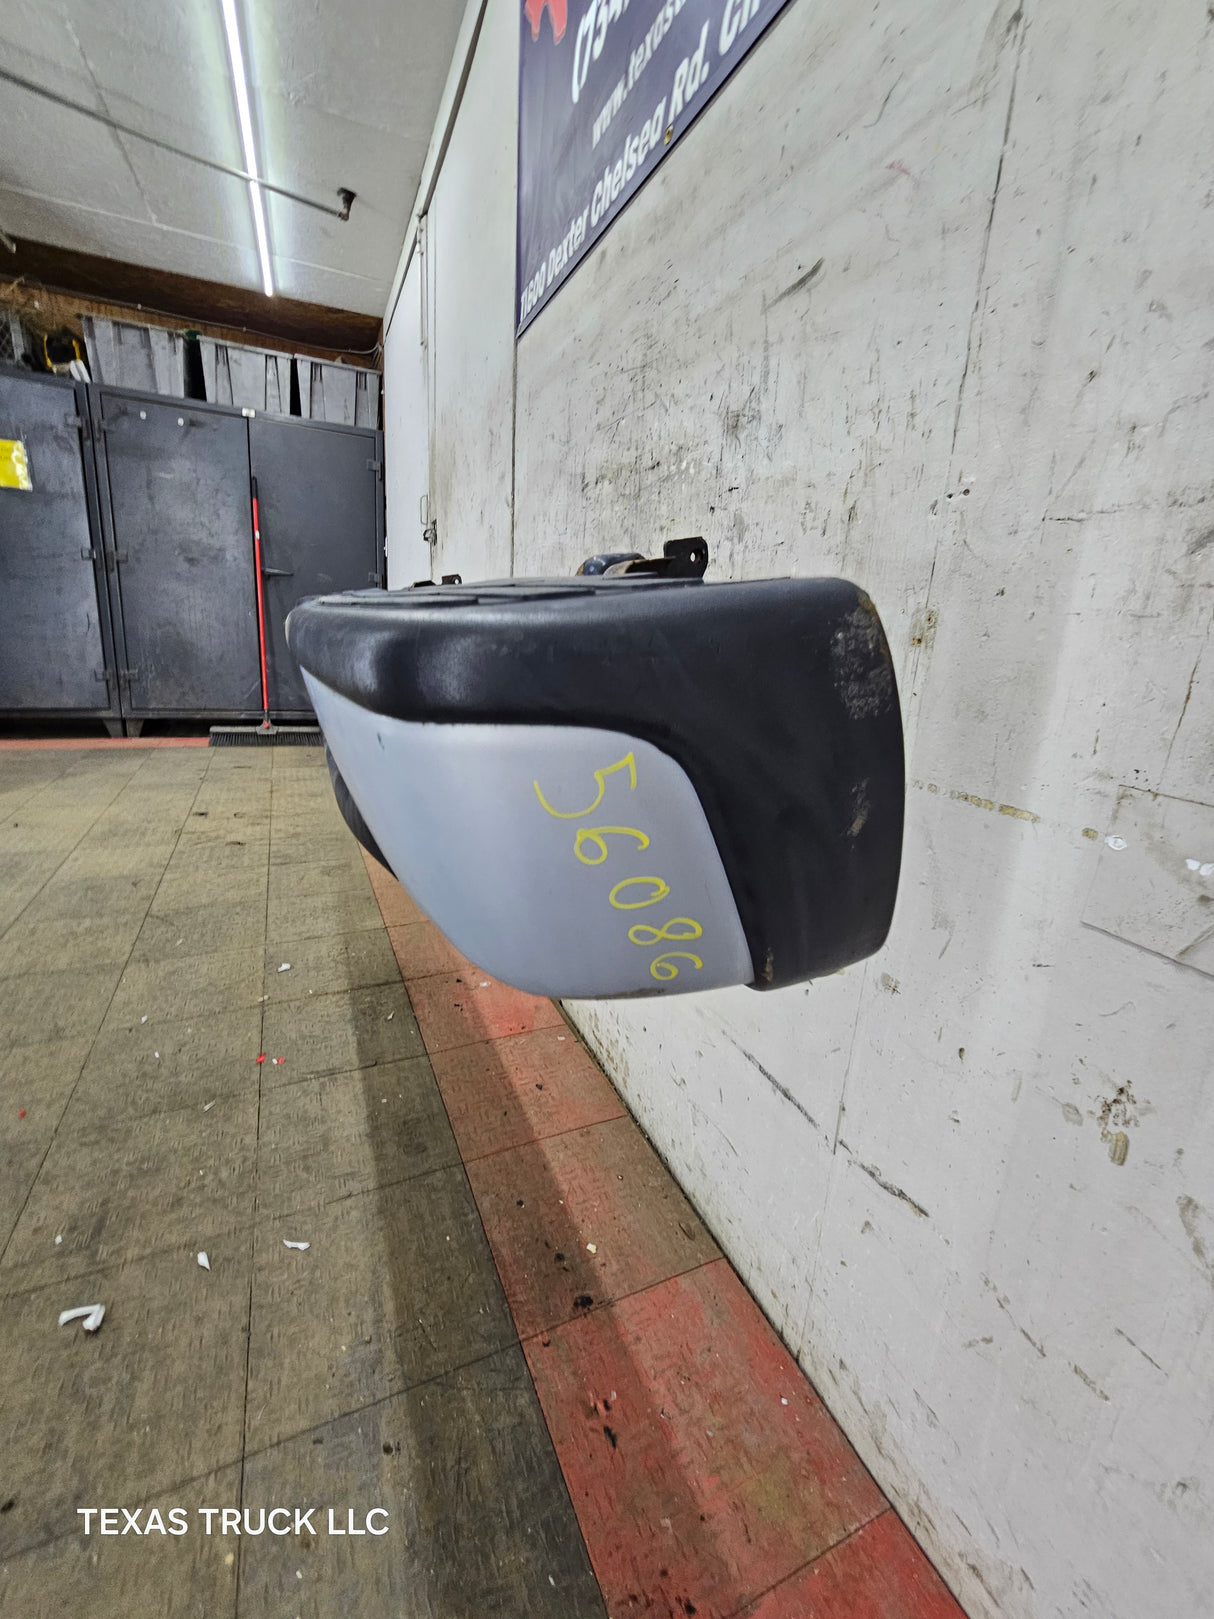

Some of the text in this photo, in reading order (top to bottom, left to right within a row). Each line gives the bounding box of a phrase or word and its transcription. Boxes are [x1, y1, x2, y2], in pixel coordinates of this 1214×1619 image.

[546, 204, 590, 288] Dexter
[591, 96, 667, 228] Chelsea
[668, 19, 710, 125] Rd.
